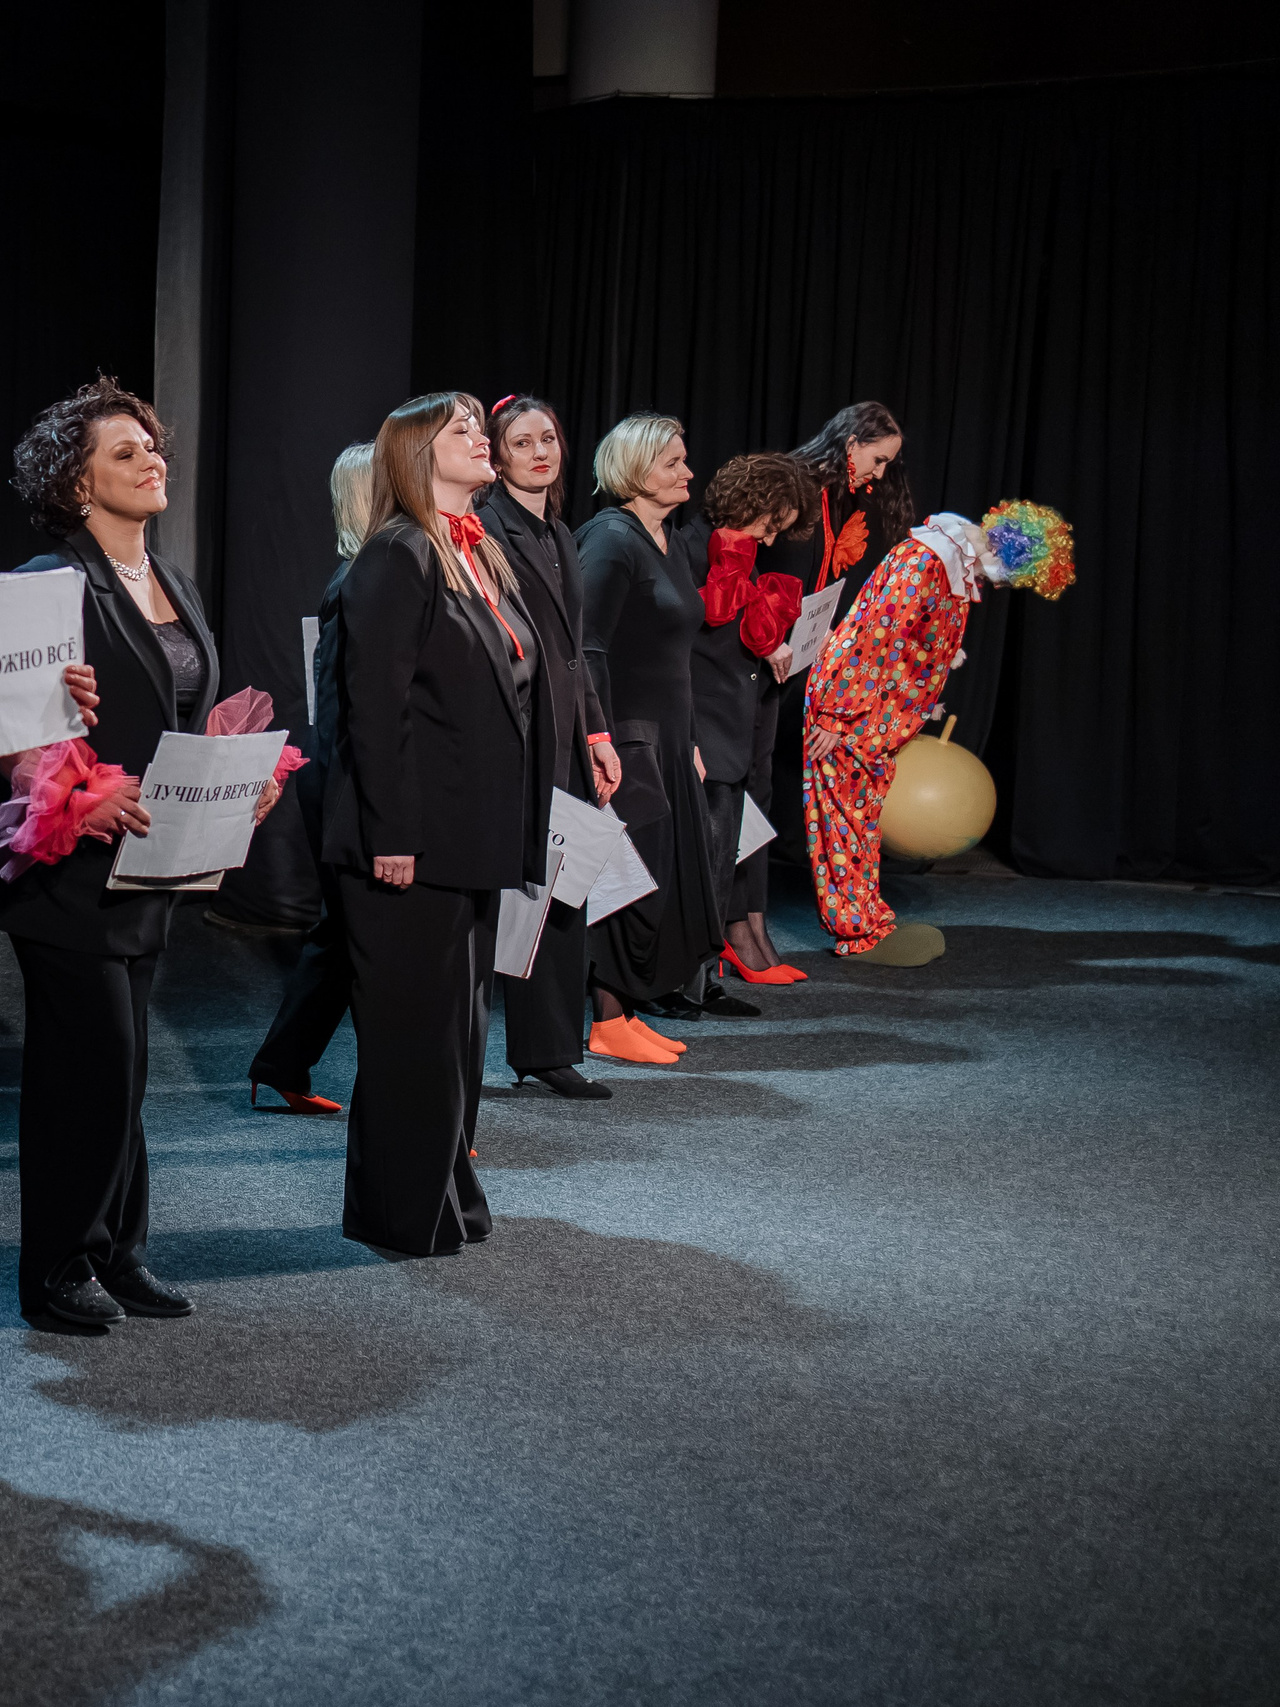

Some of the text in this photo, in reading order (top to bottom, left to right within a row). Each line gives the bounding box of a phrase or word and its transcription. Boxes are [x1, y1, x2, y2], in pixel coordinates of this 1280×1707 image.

[47, 637, 78, 665] ВСЁ
[145, 780, 269, 803] ЛУЧШАЯ ВЕРСИЯ
